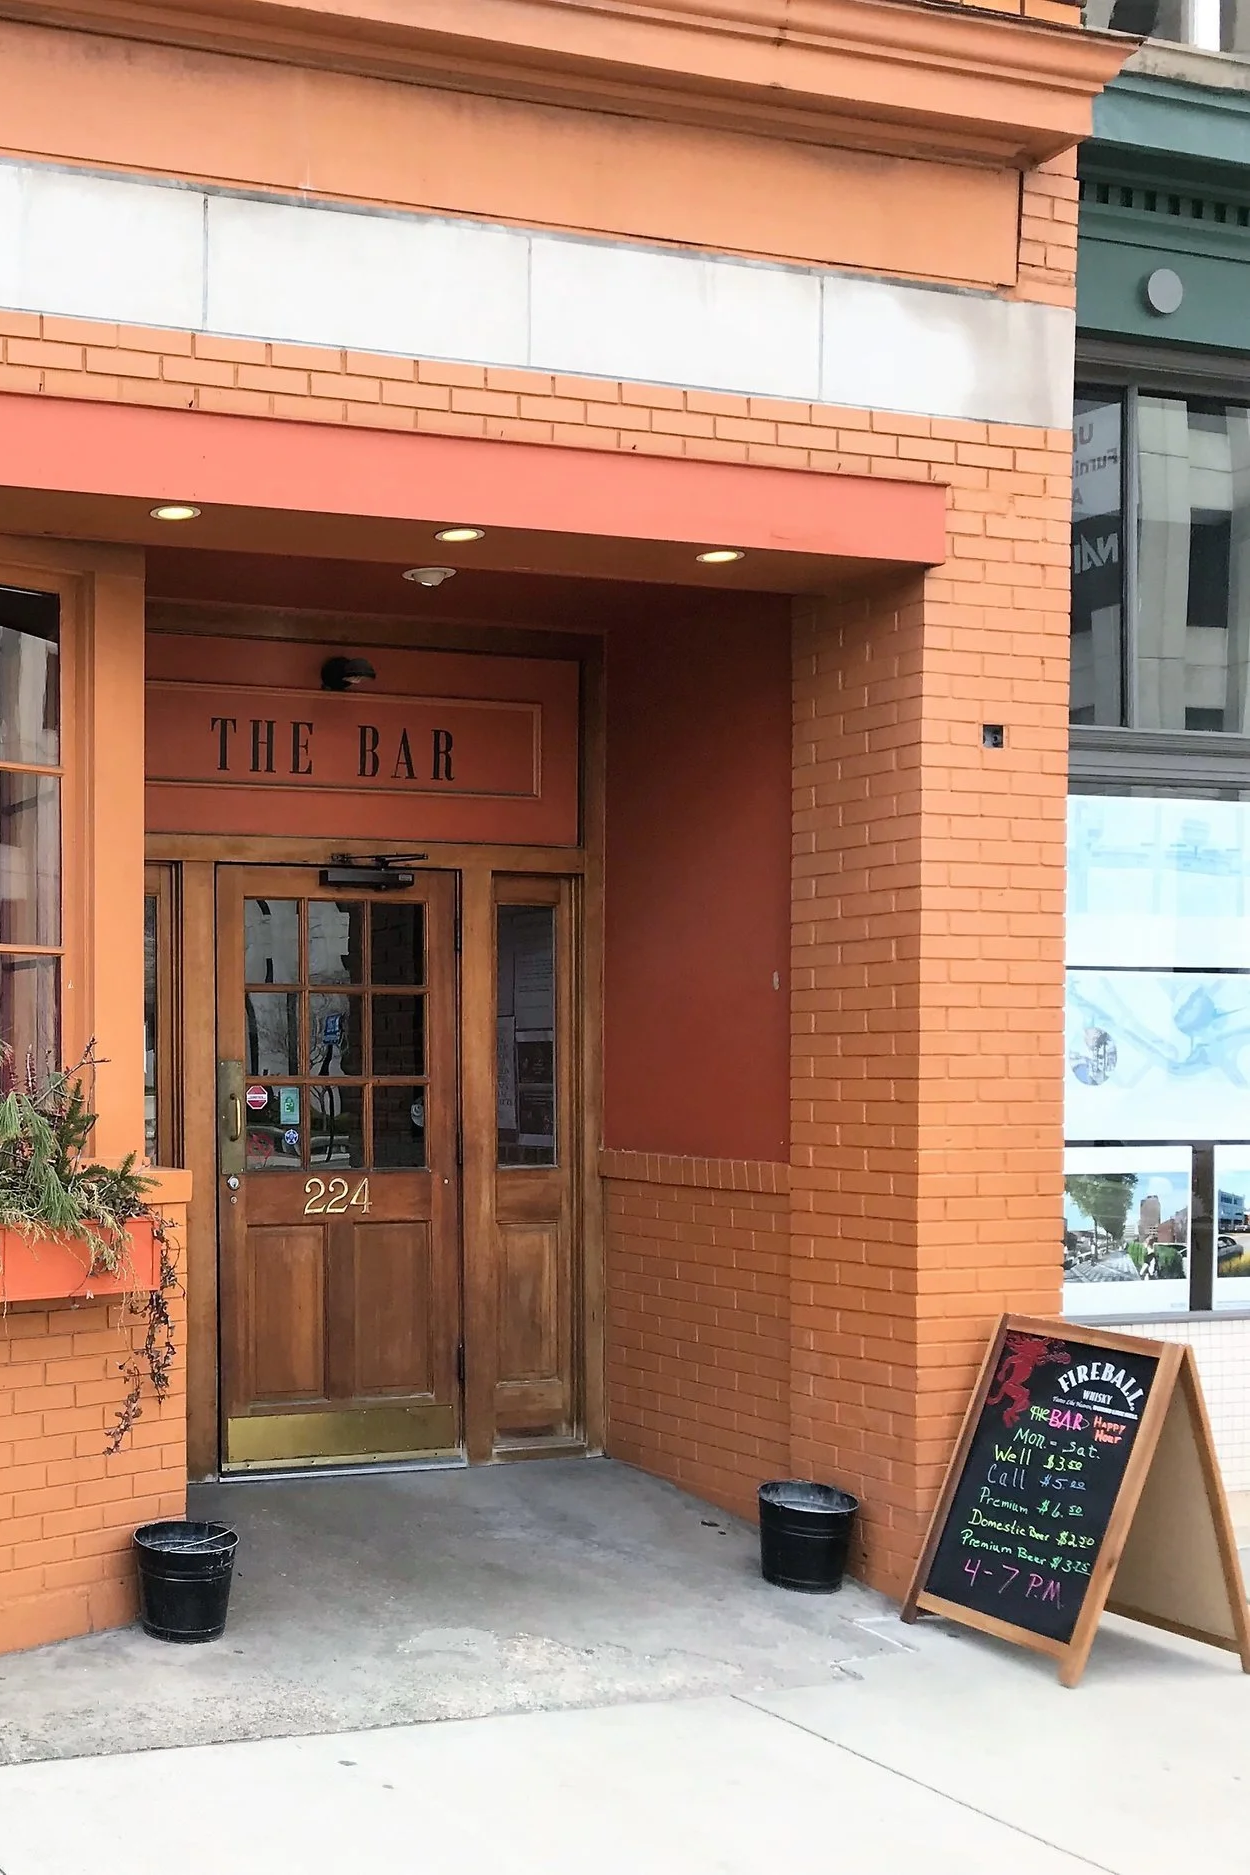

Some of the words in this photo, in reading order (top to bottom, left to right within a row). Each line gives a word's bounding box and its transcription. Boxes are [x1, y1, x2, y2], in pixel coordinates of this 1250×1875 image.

[210, 717, 314, 775] THE
[356, 724, 455, 782] BAR
[303, 1177, 373, 1215] 224
[1057, 1362, 1144, 1409] FIREBALL
[1082, 1389, 1113, 1405] WHISKY
[1048, 1408, 1083, 1431] BAR
[994, 1444, 1032, 1466] Well
[1042, 1454, 1083, 1471] $3.50
[987, 1463, 1025, 1490] Call
[979, 1486, 1029, 1515] Premium
[968, 1508, 1027, 1537] Domestic
[1028, 1525, 1051, 1542] Beer
[960, 1528, 1012, 1554] Premium
[1016, 1546, 1048, 1566] Beer
